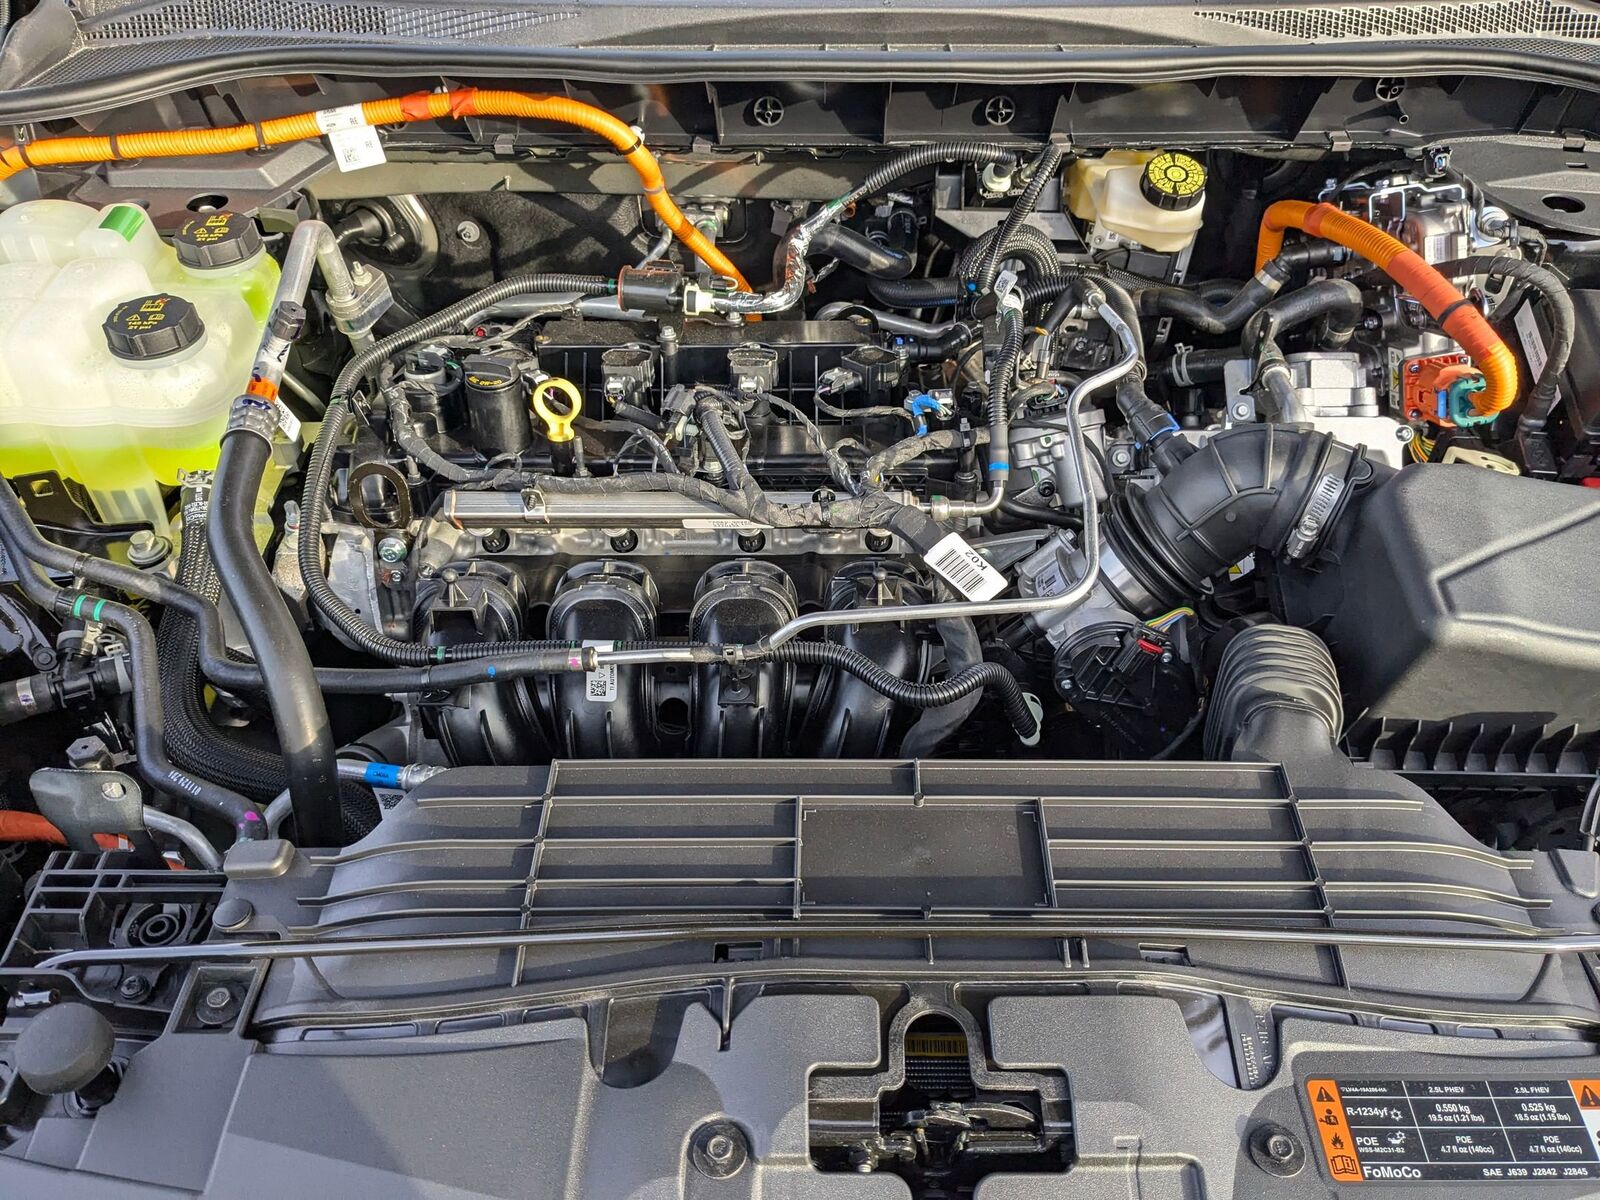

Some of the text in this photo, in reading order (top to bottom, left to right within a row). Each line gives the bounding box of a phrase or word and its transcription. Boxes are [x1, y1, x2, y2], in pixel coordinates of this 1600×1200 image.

[965, 550, 987, 571] K02
[1346, 1107, 1388, 1118] R-1234yf
[1435, 1104, 1471, 1114] 0.550 kg
[1521, 1103, 1556, 1113] 0.525 kg
[1453, 1114, 1470, 1123] (1.21
[1471, 1114, 1485, 1123] lbs)
[1539, 1113, 1557, 1122] (1.15
[1557, 1113, 1571, 1122] lbs)
[1356, 1137, 1379, 1146] POE
[1468, 1146, 1494, 1155] (140cc)
[1556, 1145, 1582, 1154] (140cc)
[1363, 1166, 1421, 1178] FoMoCo
[1483, 1168, 1588, 1176] SAE J639 J2842 J2845
